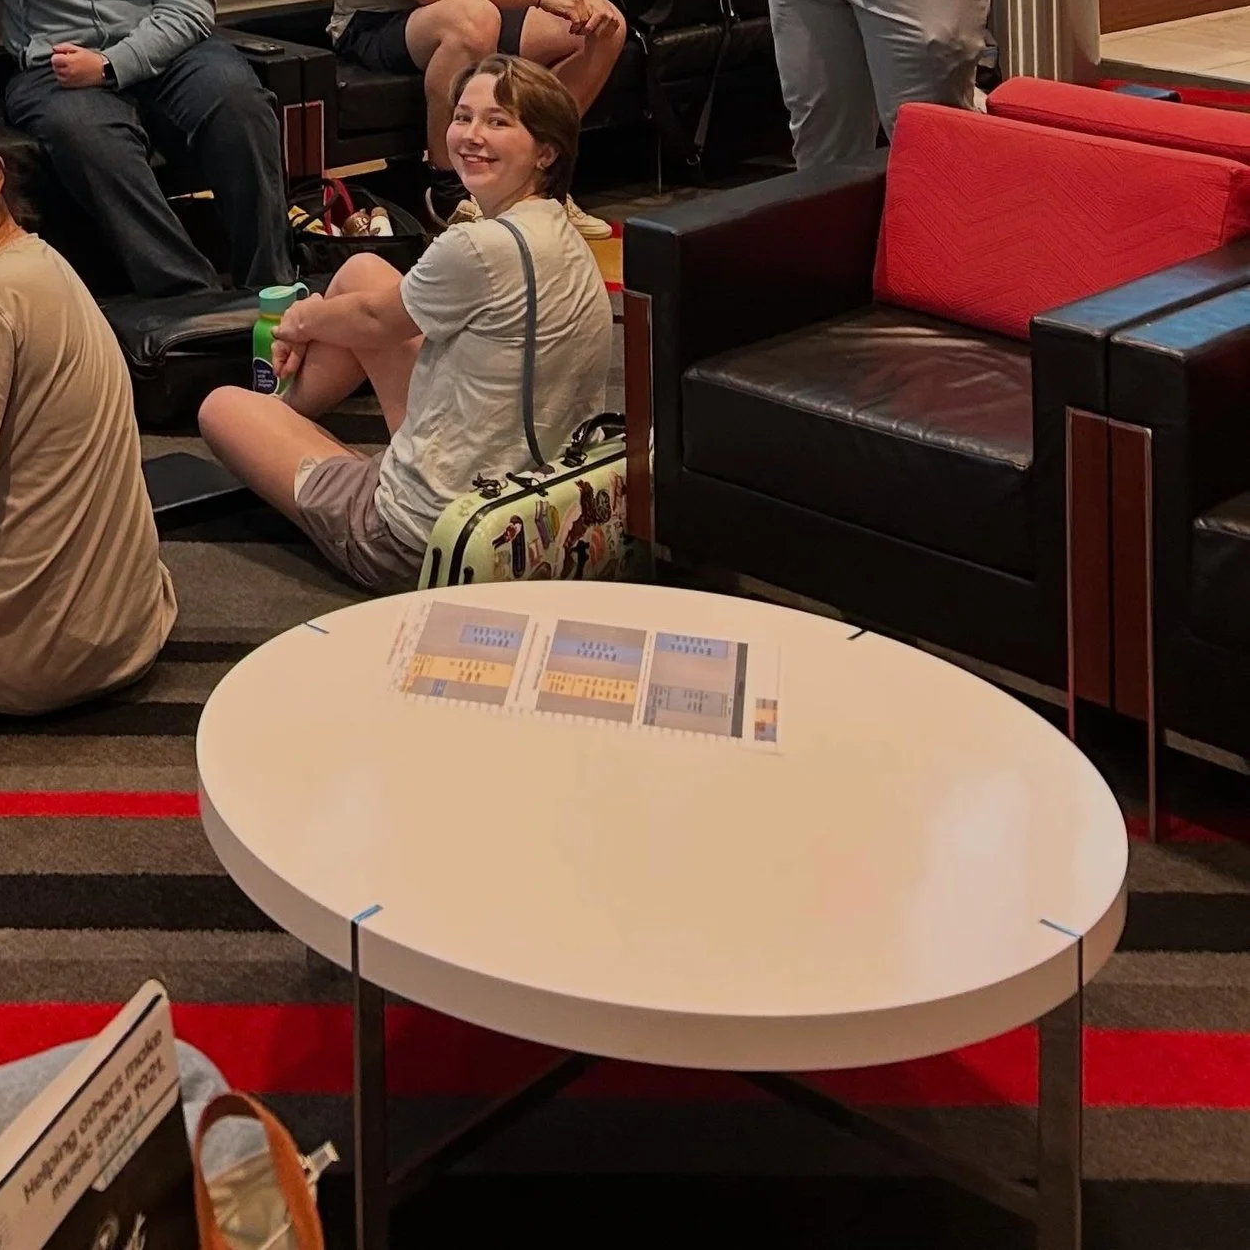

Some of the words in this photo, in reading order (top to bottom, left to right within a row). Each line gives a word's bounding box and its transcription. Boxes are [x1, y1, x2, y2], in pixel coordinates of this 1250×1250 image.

[22, 1130, 78, 1203] Helping
[79, 1075, 125, 1135] others
[124, 1029, 163, 1080] make
[51, 1142, 94, 1202] music
[95, 1096, 133, 1148] since
